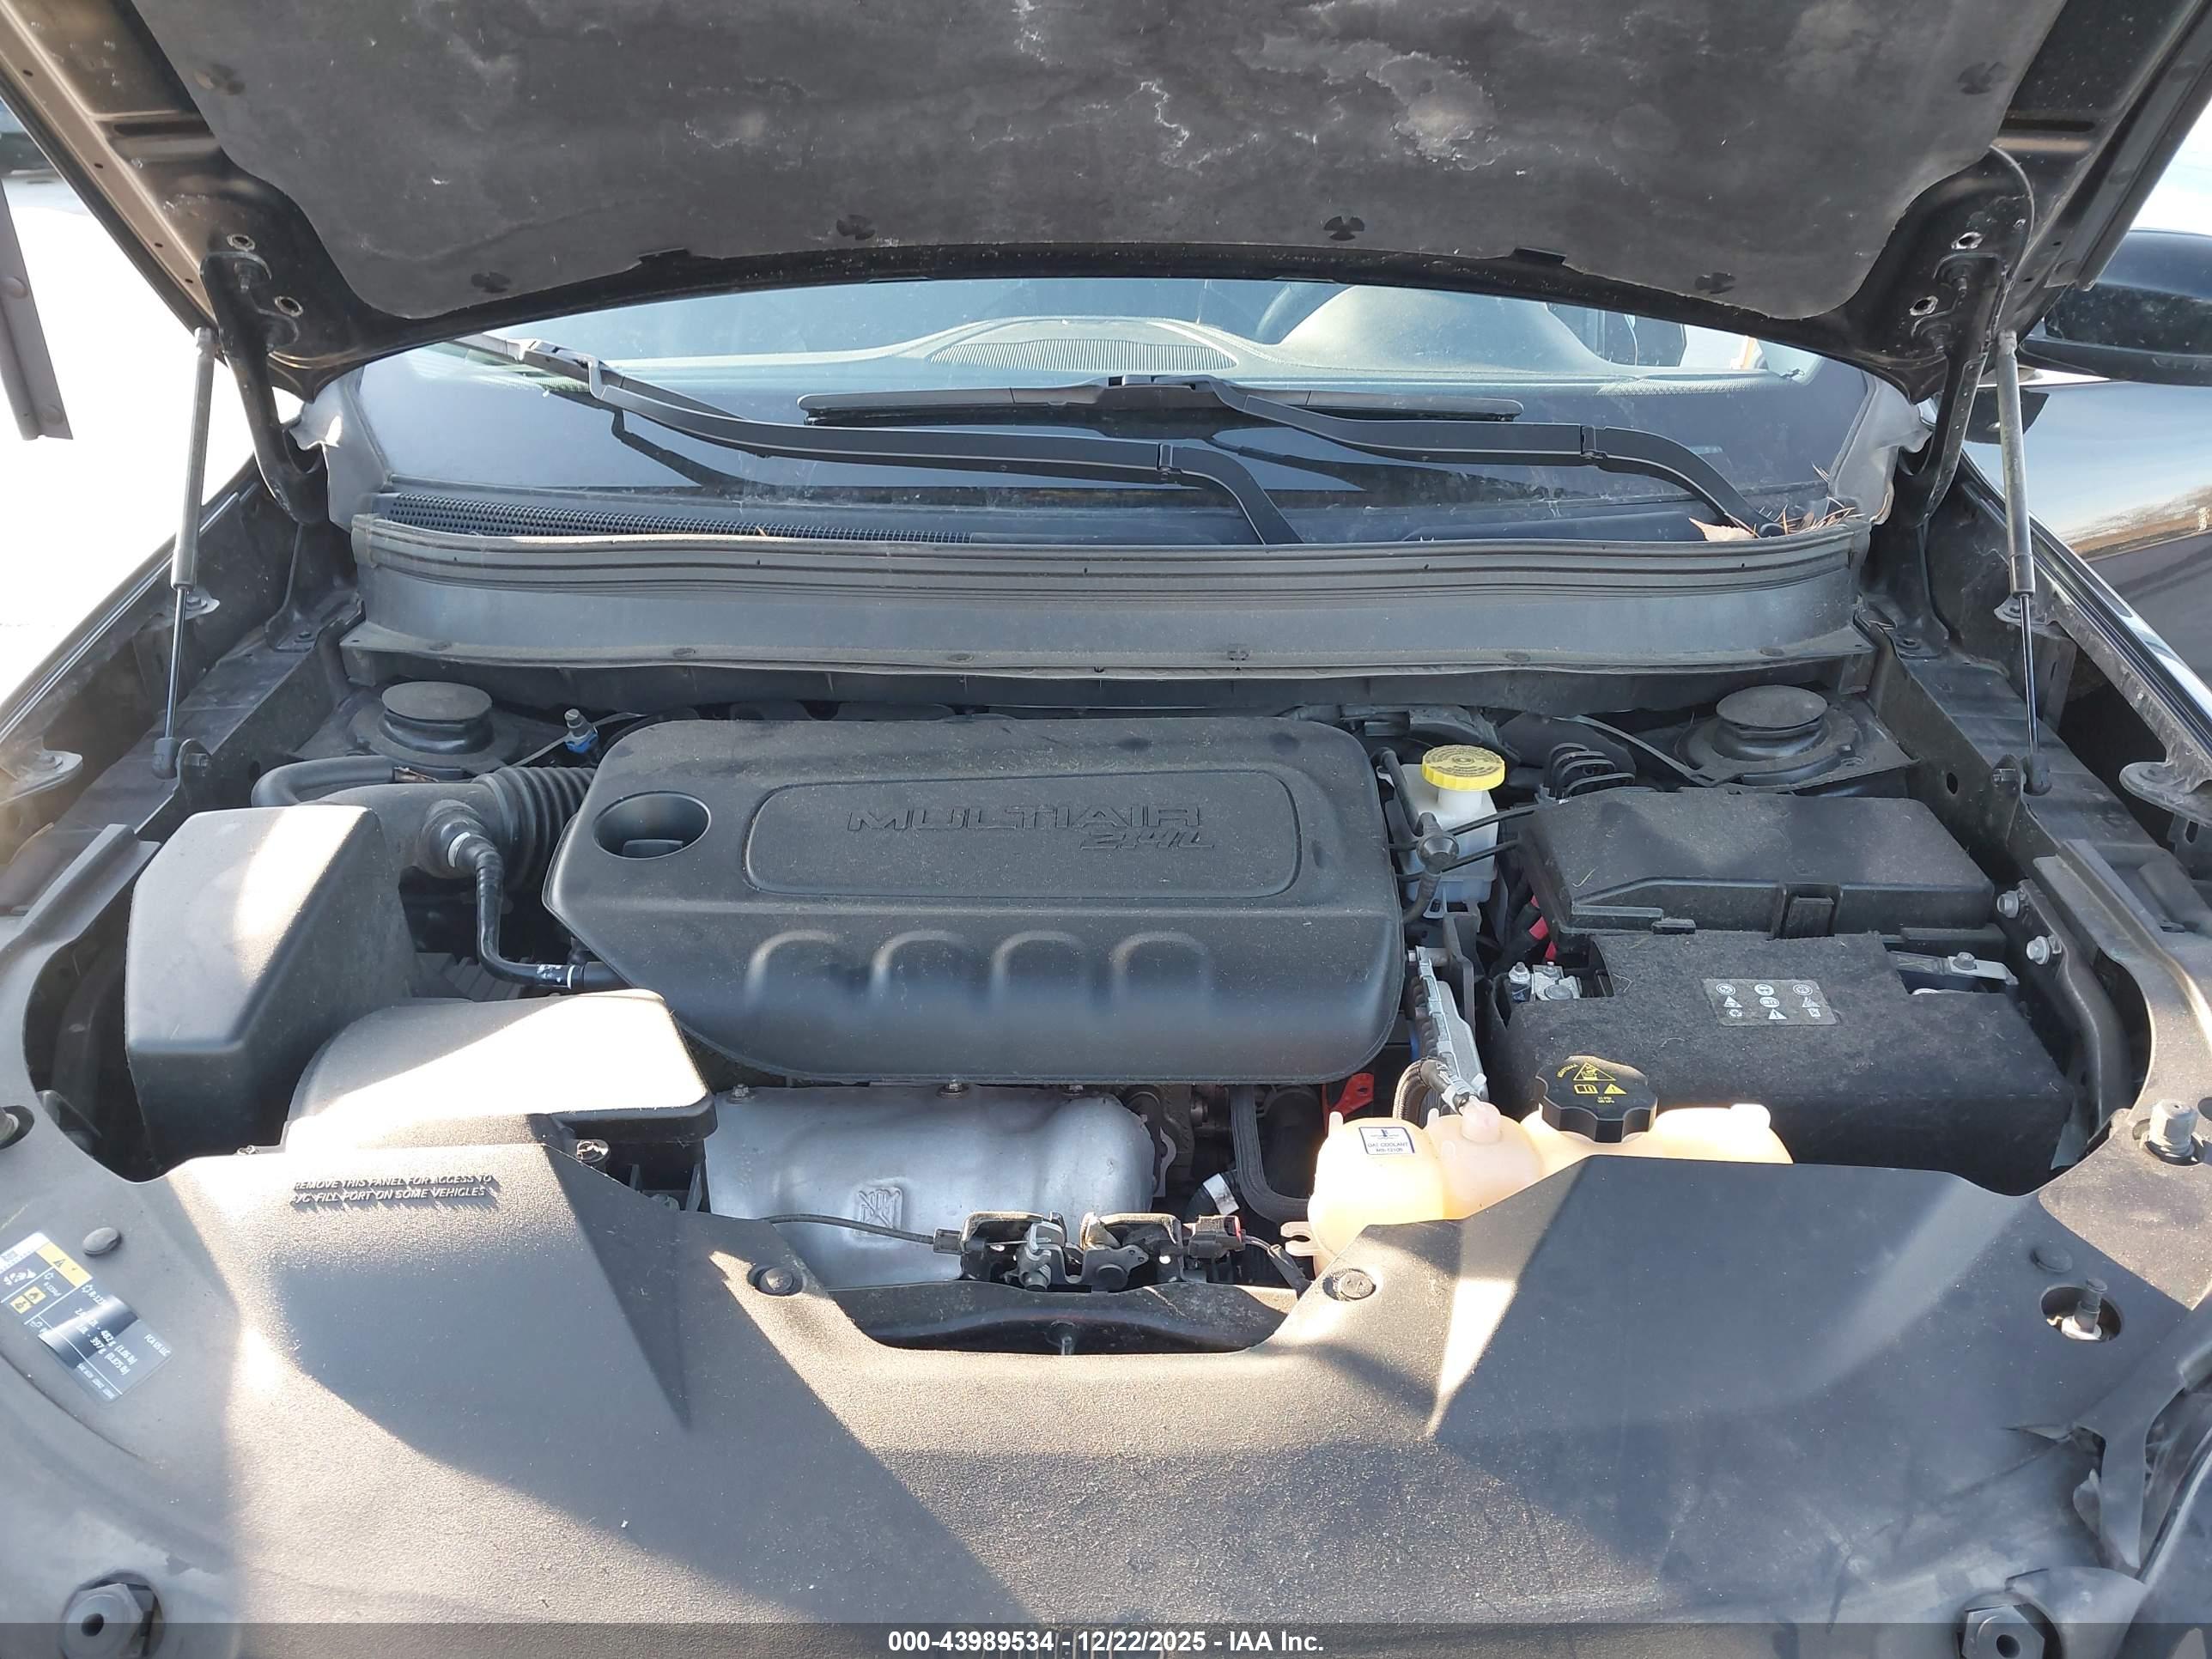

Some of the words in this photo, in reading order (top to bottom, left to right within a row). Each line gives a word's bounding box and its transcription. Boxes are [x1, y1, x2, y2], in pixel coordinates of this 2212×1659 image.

[847, 804, 1202, 832] MULTIAIR
[294, 1181, 340, 1190] REMOVE
[341, 1179, 367, 1188] THIS
[368, 1177, 405, 1187] PANEL
[407, 1176, 430, 1185] FOR
[430, 1175, 474, 1184] ACCESS
[316, 1192, 339, 1202] FILL
[342, 1190, 372, 1200] PORT
[374, 1189, 394, 1200] ON
[394, 1188, 429, 1199] SOME
[430, 1187, 487, 1197] VEHICLES
[89, 1336, 105, 1349] 397
[100, 1330, 113, 1343] 482
